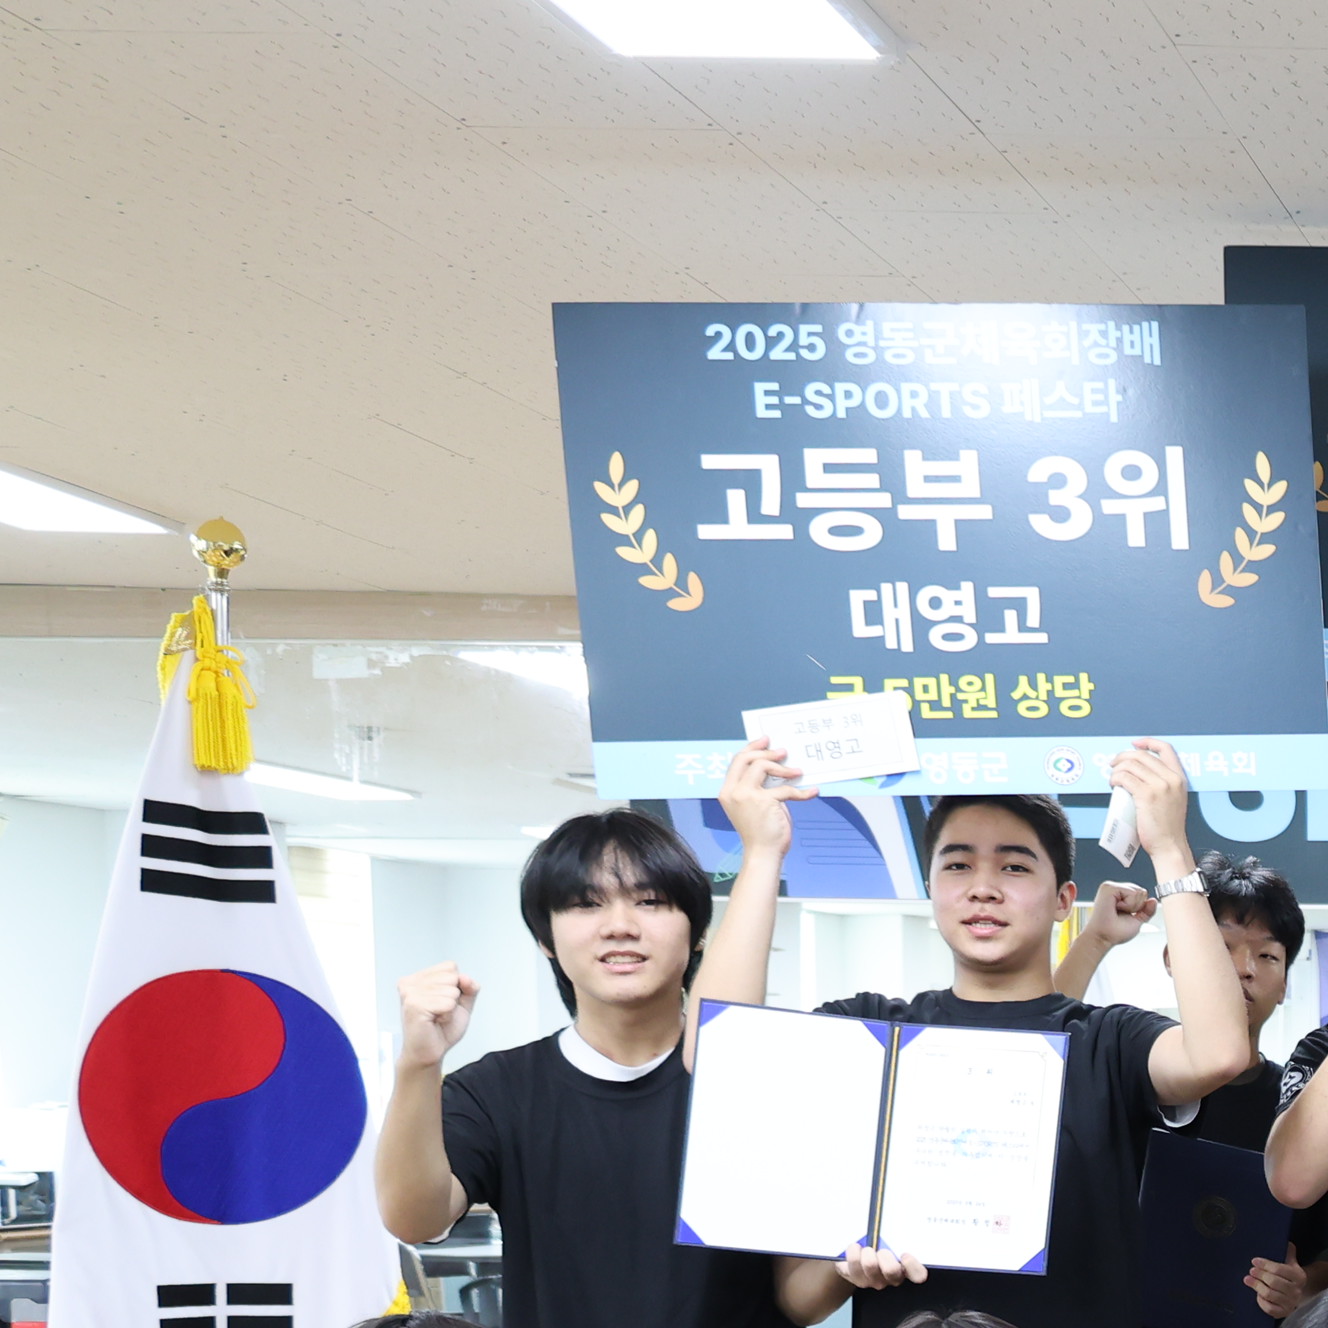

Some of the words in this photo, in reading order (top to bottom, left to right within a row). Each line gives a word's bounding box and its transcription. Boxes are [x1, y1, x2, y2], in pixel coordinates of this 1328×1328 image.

[706, 324, 826, 360] 2025
[838, 320, 1162, 367] 영동군체육회장배
[753, 381, 990, 419] E-SPORTS
[1004, 379, 1122, 425] 페스타
[696, 447, 993, 551] 고등부
[1026, 445, 1189, 550] 3위
[849, 581, 1048, 652] 대영고
[884, 674, 999, 719] 5만원
[1011, 673, 1094, 718] 상당
[794, 718, 833, 734] 고등부
[844, 713, 863, 728] 3위
[805, 738, 863, 761] 대영고
[921, 752, 1008, 783] 영동군
[1092, 750, 1257, 777] 체육회
